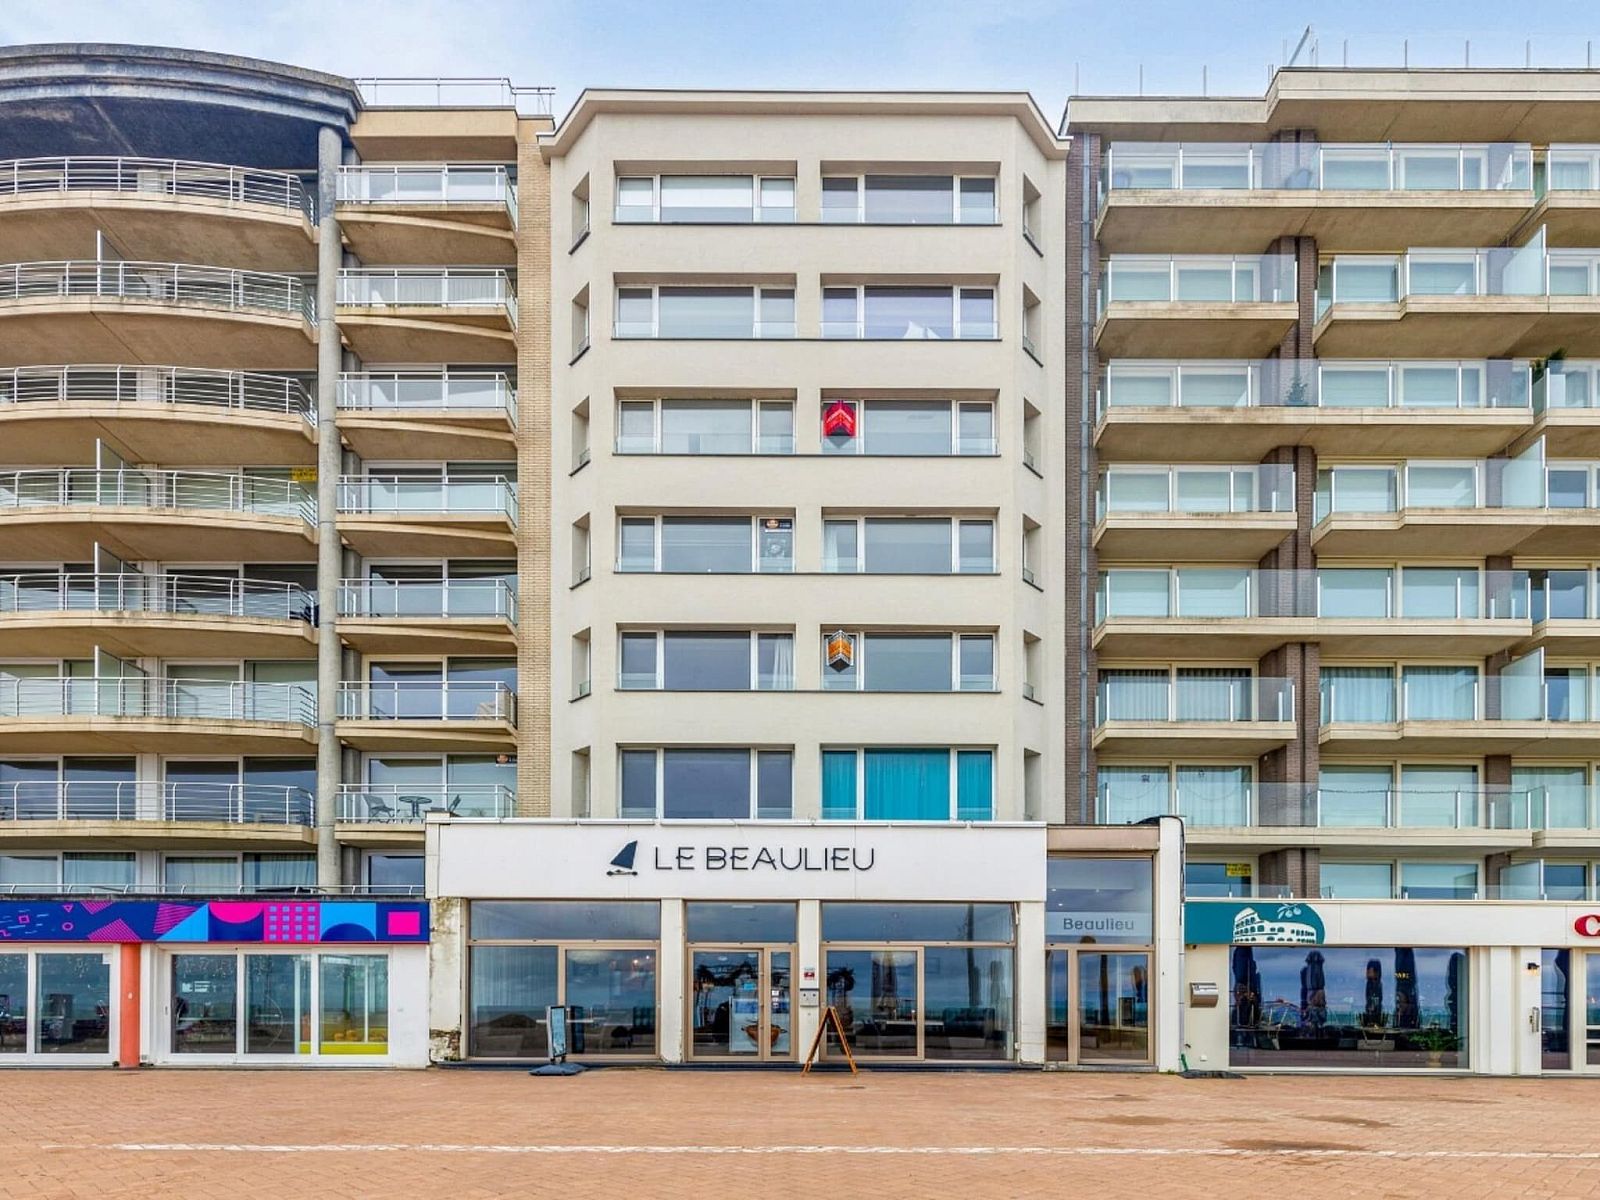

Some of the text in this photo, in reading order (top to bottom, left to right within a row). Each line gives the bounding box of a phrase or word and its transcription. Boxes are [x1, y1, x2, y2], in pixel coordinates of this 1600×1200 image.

[655, 846, 875, 871] LE BEAULIEU
[1063, 917, 1135, 931] Beaulieu
